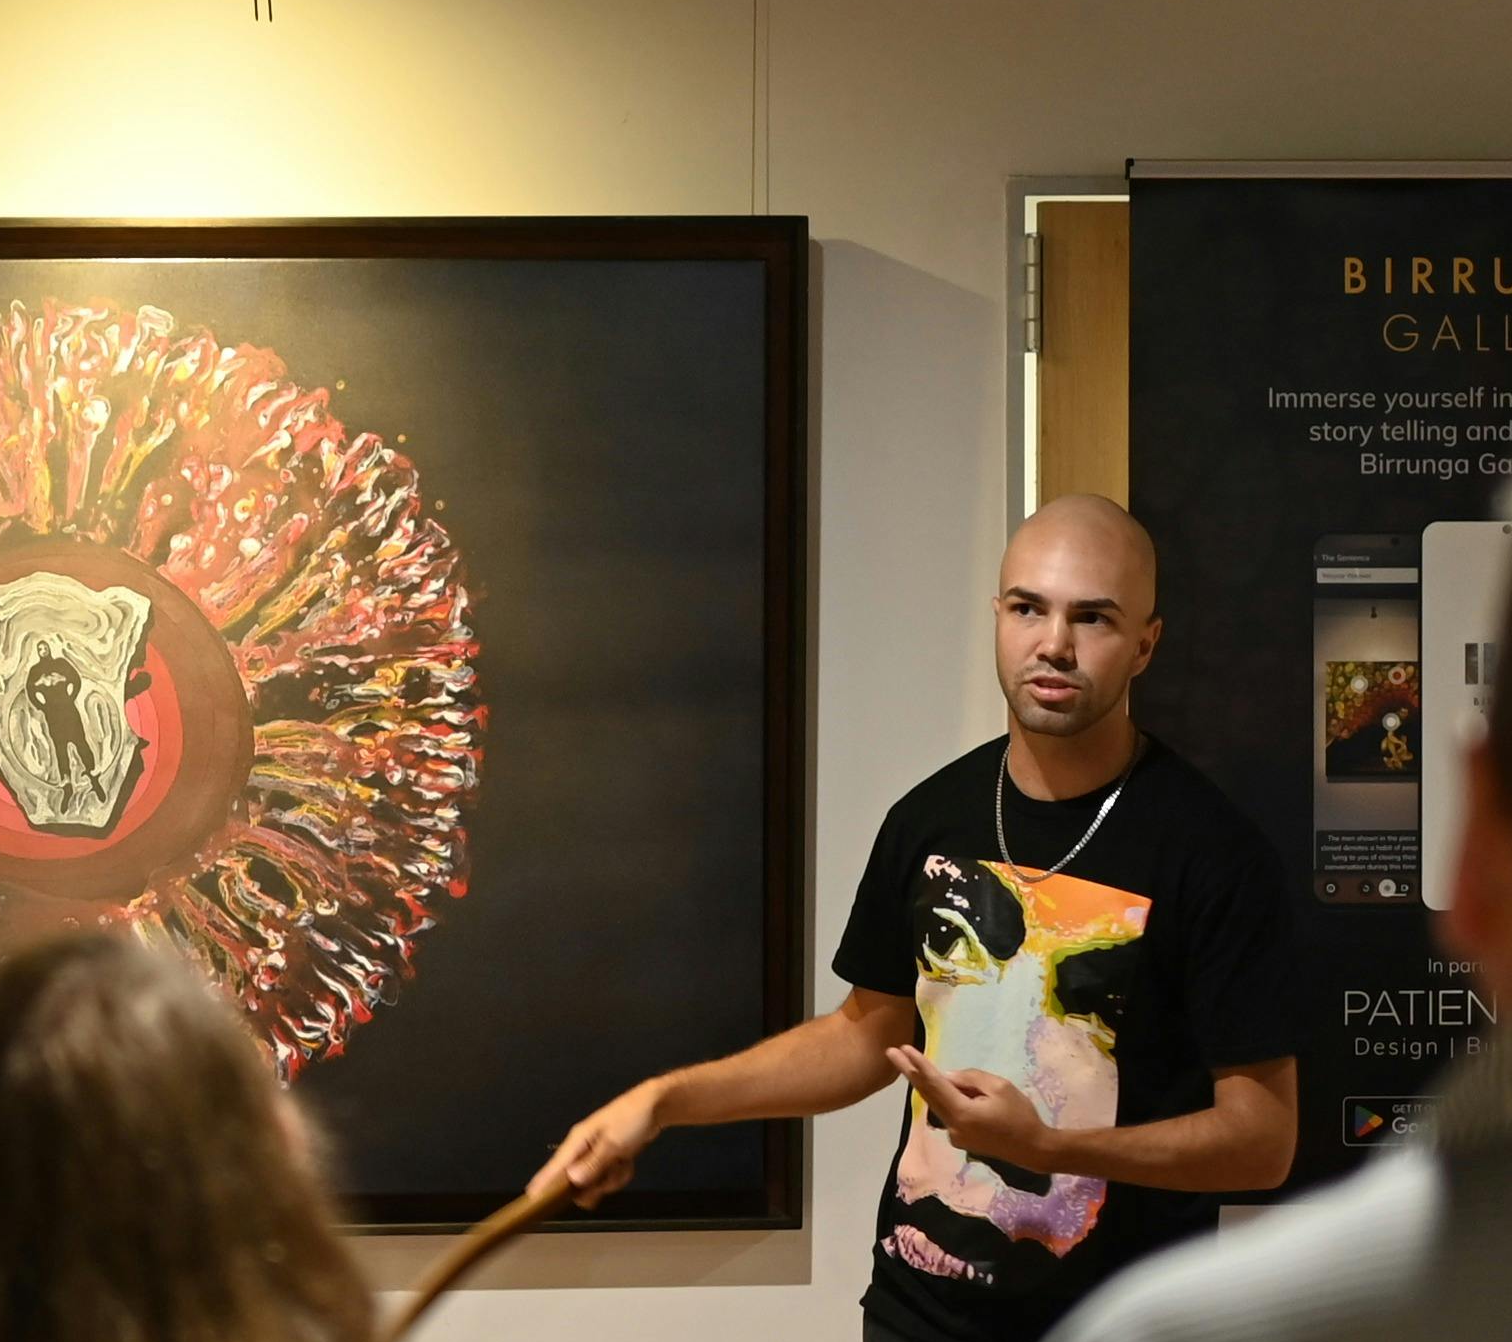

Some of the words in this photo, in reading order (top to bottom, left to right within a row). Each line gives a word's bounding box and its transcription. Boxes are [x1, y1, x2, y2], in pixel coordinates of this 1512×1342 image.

[1268, 386, 1376, 409] Immerse
[1384, 386, 1485, 415] yourself
[1309, 421, 1374, 448] story
[1380, 419, 1458, 447] telling
[1360, 452, 1470, 481] Birrunga
[1428, 958, 1444, 974] In
[1344, 989, 1498, 1026] PATIEN
[1355, 1036, 1438, 1060] Design
[1392, 1103, 1411, 1114] GET
